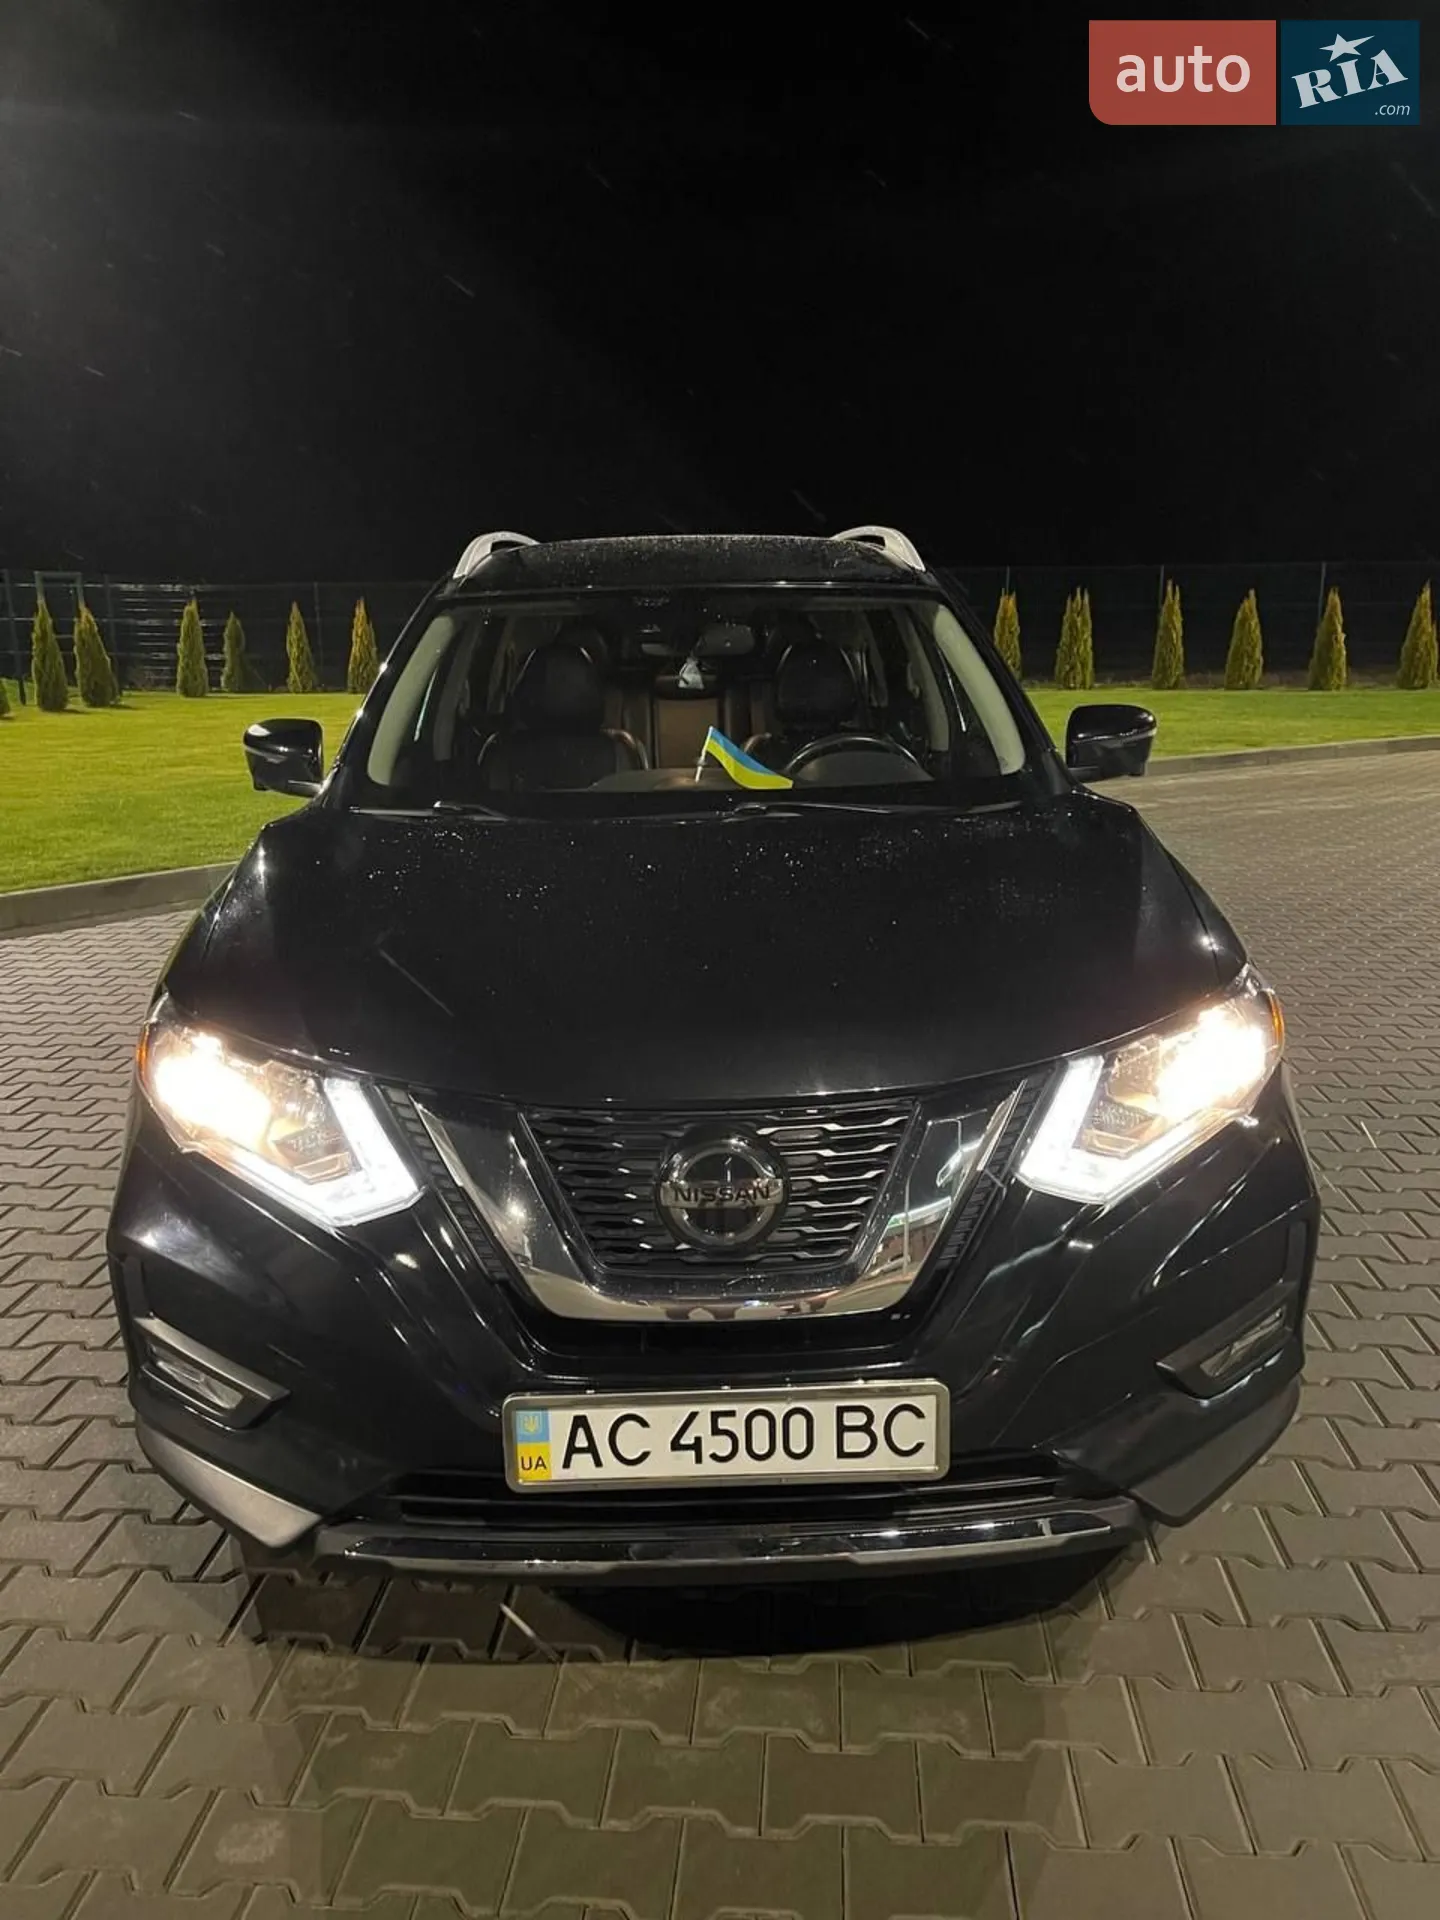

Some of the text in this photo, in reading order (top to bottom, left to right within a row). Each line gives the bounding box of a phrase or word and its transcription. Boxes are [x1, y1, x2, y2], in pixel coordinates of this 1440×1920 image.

[673, 1184, 771, 1202] NISSAN
[561, 1403, 926, 1469] AC 4500 BC
[520, 1455, 547, 1471] UA
